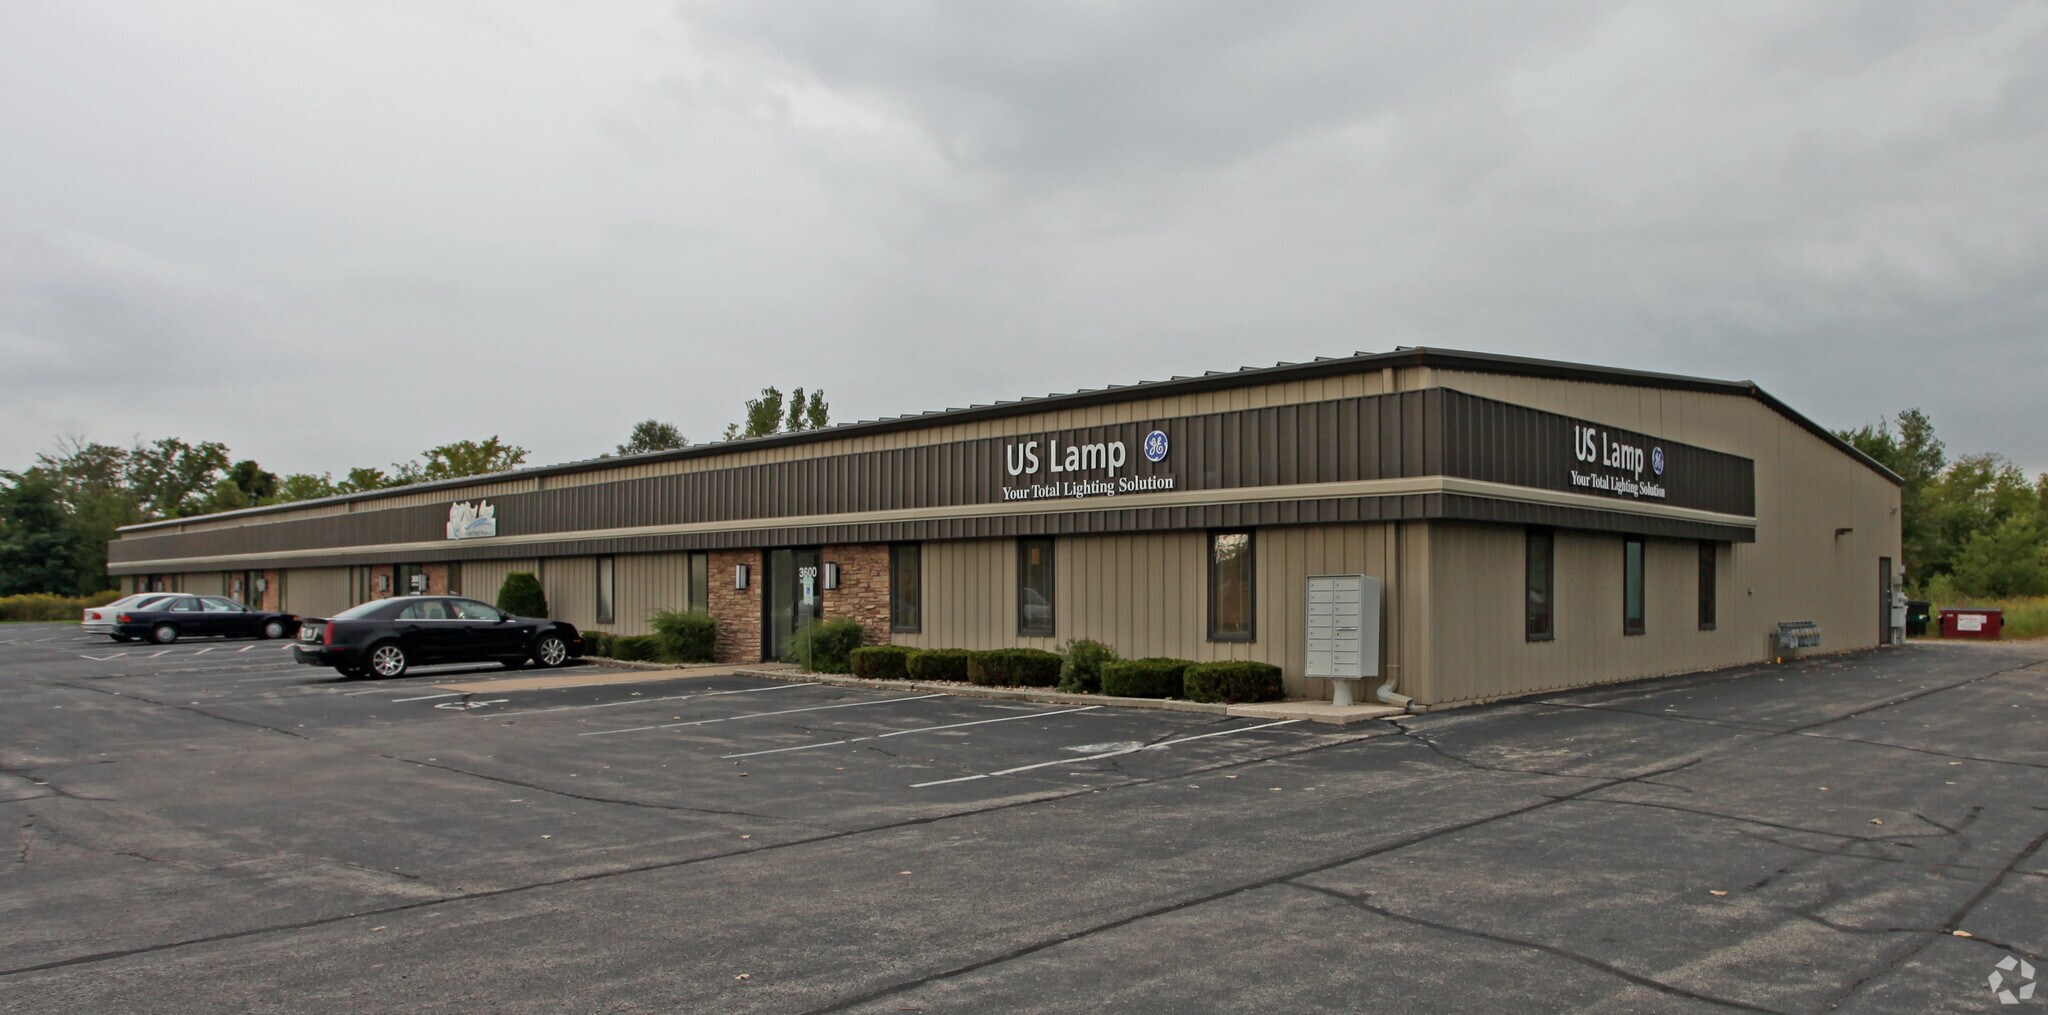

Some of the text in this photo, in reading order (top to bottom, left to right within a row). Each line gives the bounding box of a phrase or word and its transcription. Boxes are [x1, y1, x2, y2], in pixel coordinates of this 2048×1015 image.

[1007, 440, 1126, 477] US Lamp
[1575, 425, 1644, 480] US Lamp
[1002, 475, 1173, 500] Your Total Lighting Solution
[1571, 470, 1665, 497] Your Total Lighting Solution
[799, 566, 817, 577] 3600
